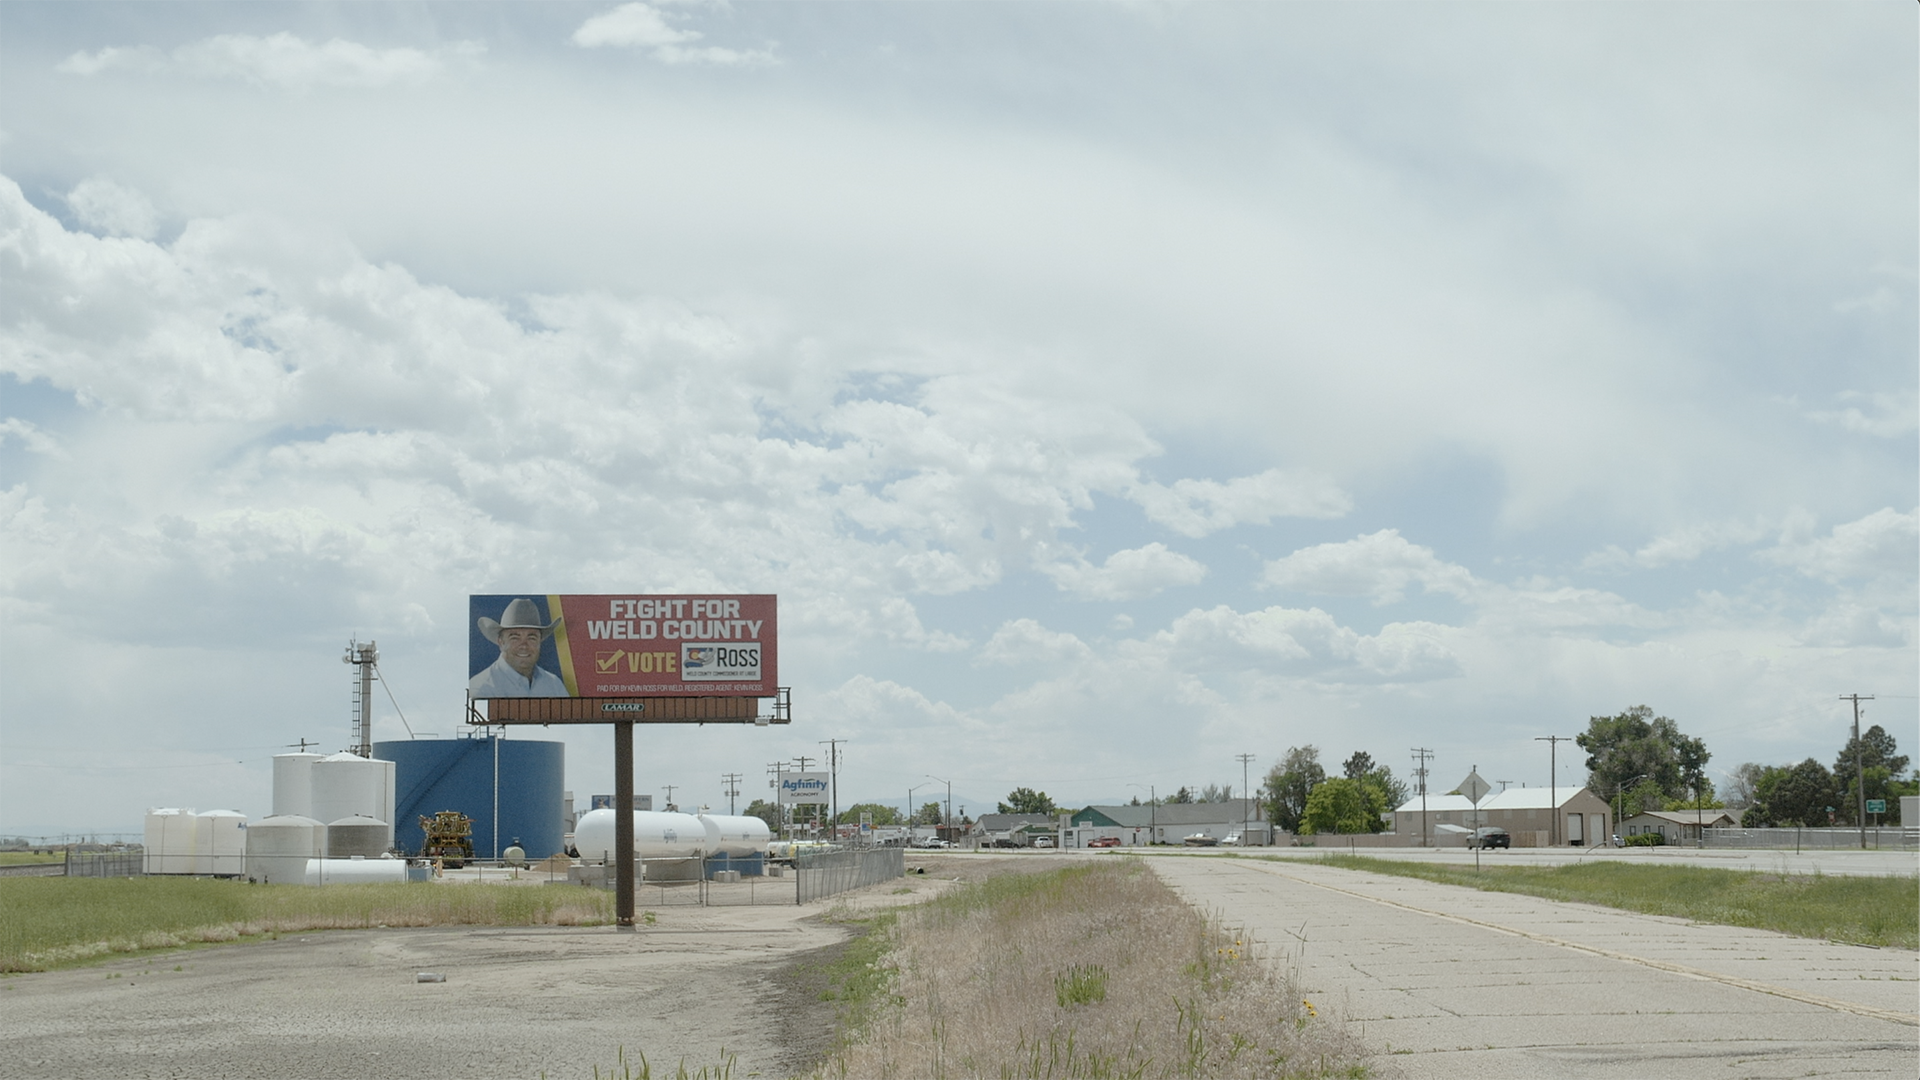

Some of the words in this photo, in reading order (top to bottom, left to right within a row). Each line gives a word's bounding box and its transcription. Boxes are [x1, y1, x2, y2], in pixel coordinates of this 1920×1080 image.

[610, 599, 688, 619] FIGHT
[692, 599, 740, 619] FOR
[587, 620, 657, 640] WELD
[662, 620, 763, 640] COUNTY
[627, 652, 677, 673] VOTE
[596, 684, 608, 692] PAID
[609, 684, 620, 692] FOR
[620, 684, 627, 692] BY
[627, 684, 642, 692] KEVIN
[643, 684, 656, 692] ROSS
[657, 684, 667, 692] FOR
[684, 684, 714, 692] REGISTERED
[733, 684, 748, 692] KEVIN
[748, 684, 763, 692] ROSS
[604, 703, 640, 711] LAMAR
[782, 778, 828, 792] Agfinity
